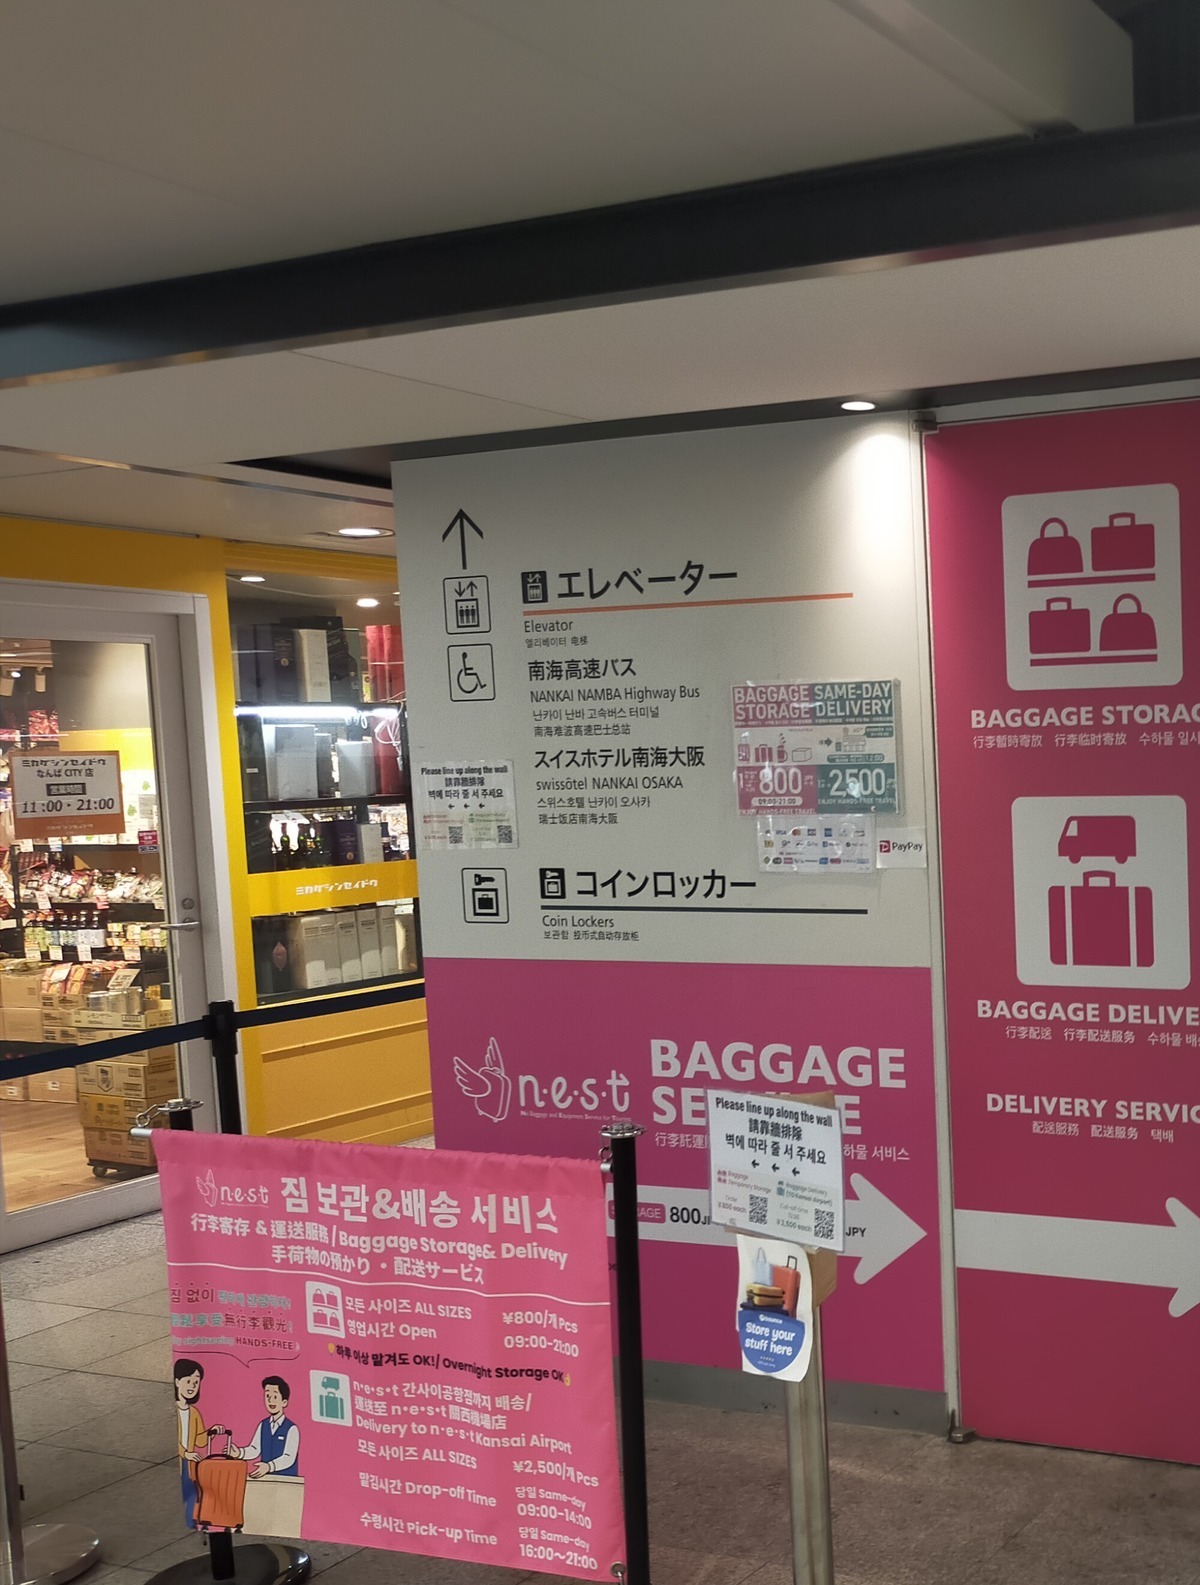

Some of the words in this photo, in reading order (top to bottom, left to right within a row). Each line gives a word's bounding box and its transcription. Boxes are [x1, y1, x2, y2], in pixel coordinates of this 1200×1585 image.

[557, 560, 738, 600] エレベーター
[524, 619, 574, 633] Elevator
[525, 637, 567, 648] 엘리베이터
[528, 658, 637, 682] 南海高速バス
[530, 690, 574, 703] NANKAI
[578, 688, 622, 701] NAMBA
[625, 686, 676, 703] Highway
[680, 685, 700, 698] Bus
[734, 685, 810, 704] BAGGAGE
[814, 682, 892, 700] SAME-DAY
[533, 709, 562, 721] 난카이
[565, 708, 585, 720] 난바
[587, 707, 627, 720] 고속버스
[629, 706, 660, 718] 터미널
[735, 702, 811, 720] STORAGE
[815, 699, 892, 718] DELIVERY
[971, 707, 1094, 729] BAGGAGE
[534, 723, 631, 737] 南海难波高速巴士总站
[1139, 732, 1174, 747] 수하물
[534, 746, 706, 769] スイスホテル南海大阪
[36, 769, 62, 779] なんば
[64, 769, 83, 777] CITY
[421, 767, 442, 775] Please
[442, 766, 454, 775] line
[455, 767, 464, 776] up
[464, 766, 482, 775] along
[483, 766, 493, 774] the
[494, 765, 508, 773] wall
[759, 767, 802, 794] 800
[472, 788, 479, 798] 서
[481, 788, 504, 799] 주세요
[536, 777, 587, 790] swissôtel
[592, 777, 638, 790] NANKAI
[642, 776, 683, 789] OSAKA
[76, 798, 115, 811] 21:00
[588, 796, 618, 808] 난카이
[620, 796, 651, 807] 오사카
[892, 842, 923, 852] PayPay
[296, 879, 379, 896] ミカゲシンセイドウ
[576, 869, 756, 899] コインロッカー
[542, 915, 568, 928] Coin
[571, 916, 615, 928] Lockers
[544, 930, 569, 940] 보관함
[977, 999, 1100, 1023] BAGGAGE
[1005, 1025, 1052, 1040] 行李配送
[1063, 1027, 1136, 1044] 行李配送服务
[1147, 1032, 1182, 1047] 수하물
[650, 1039, 906, 1089] BAGGAGE
[715, 1097, 745, 1112] Please
[746, 1101, 762, 1114] line
[764, 1106, 775, 1119] up
[776, 1107, 800, 1123] along
[801, 1111, 814, 1123] the
[816, 1115, 833, 1127] wall
[986, 1093, 1107, 1118] DELIVERY
[1090, 1124, 1139, 1140] 配送服务
[1151, 1129, 1174, 1143] 택배
[725, 1133, 745, 1150] 벽에
[747, 1137, 767, 1154] 따라
[770, 1141, 781, 1157] 줄
[784, 1144, 793, 1159] 서
[796, 1146, 827, 1165] 주세요
[872, 1147, 910, 1161] 서비스
[280, 1177, 309, 1214] 짐
[317, 1182, 461, 1228] 보관&배송
[471, 1194, 559, 1233] 서비스
[669, 1206, 701, 1224] 800
[845, 1227, 867, 1238] JPY
[190, 1213, 250, 1237] 行李寄存
[255, 1222, 268, 1236] &
[501, 1242, 568, 1271] Delivery
[186, 1289, 214, 1303] 없이
[345, 1296, 365, 1314] 모든
[368, 1298, 412, 1315] 사이즈
[415, 1301, 436, 1316] ALL
[438, 1305, 472, 1320] SIZES
[347, 1319, 396, 1338] 영업시간
[399, 1324, 437, 1340] Open
[745, 1322, 770, 1336] Store
[771, 1325, 796, 1342] your
[236, 1337, 293, 1350] HANDS-FREE
[504, 1335, 579, 1357] 09:00-21:00
[745, 1338, 768, 1351] stuff
[770, 1341, 793, 1356] here
[336, 1345, 352, 1360] 하루
[353, 1350, 369, 1365] 이상
[371, 1353, 410, 1367] 맡겨도
[442, 1357, 492, 1379] Overnight
[495, 1367, 550, 1381] Storage
[551, 1369, 564, 1383] OK
[402, 1382, 492, 1411] 간사이공항점까지
[356, 1415, 407, 1438] Delivery
[411, 1421, 427, 1434] to
[530, 1433, 573, 1455] Airport
[357, 1438, 376, 1457] 모든
[378, 1445, 419, 1461] 사이즈
[422, 1448, 446, 1462] ALL
[449, 1451, 477, 1469] SIZES
[359, 1471, 402, 1495] 맡김시간
[405, 1482, 465, 1499] Drop-off
[466, 1489, 497, 1507] Time
[515, 1486, 536, 1498] 당일
[538, 1488, 586, 1512] Same-day
[517, 1503, 592, 1529] 09:00-14:00
[360, 1512, 405, 1533] 수령시간
[407, 1521, 463, 1543] Pick-up
[464, 1529, 497, 1545] Time
[518, 1526, 538, 1540] 당일
[540, 1530, 590, 1553] Same-day
